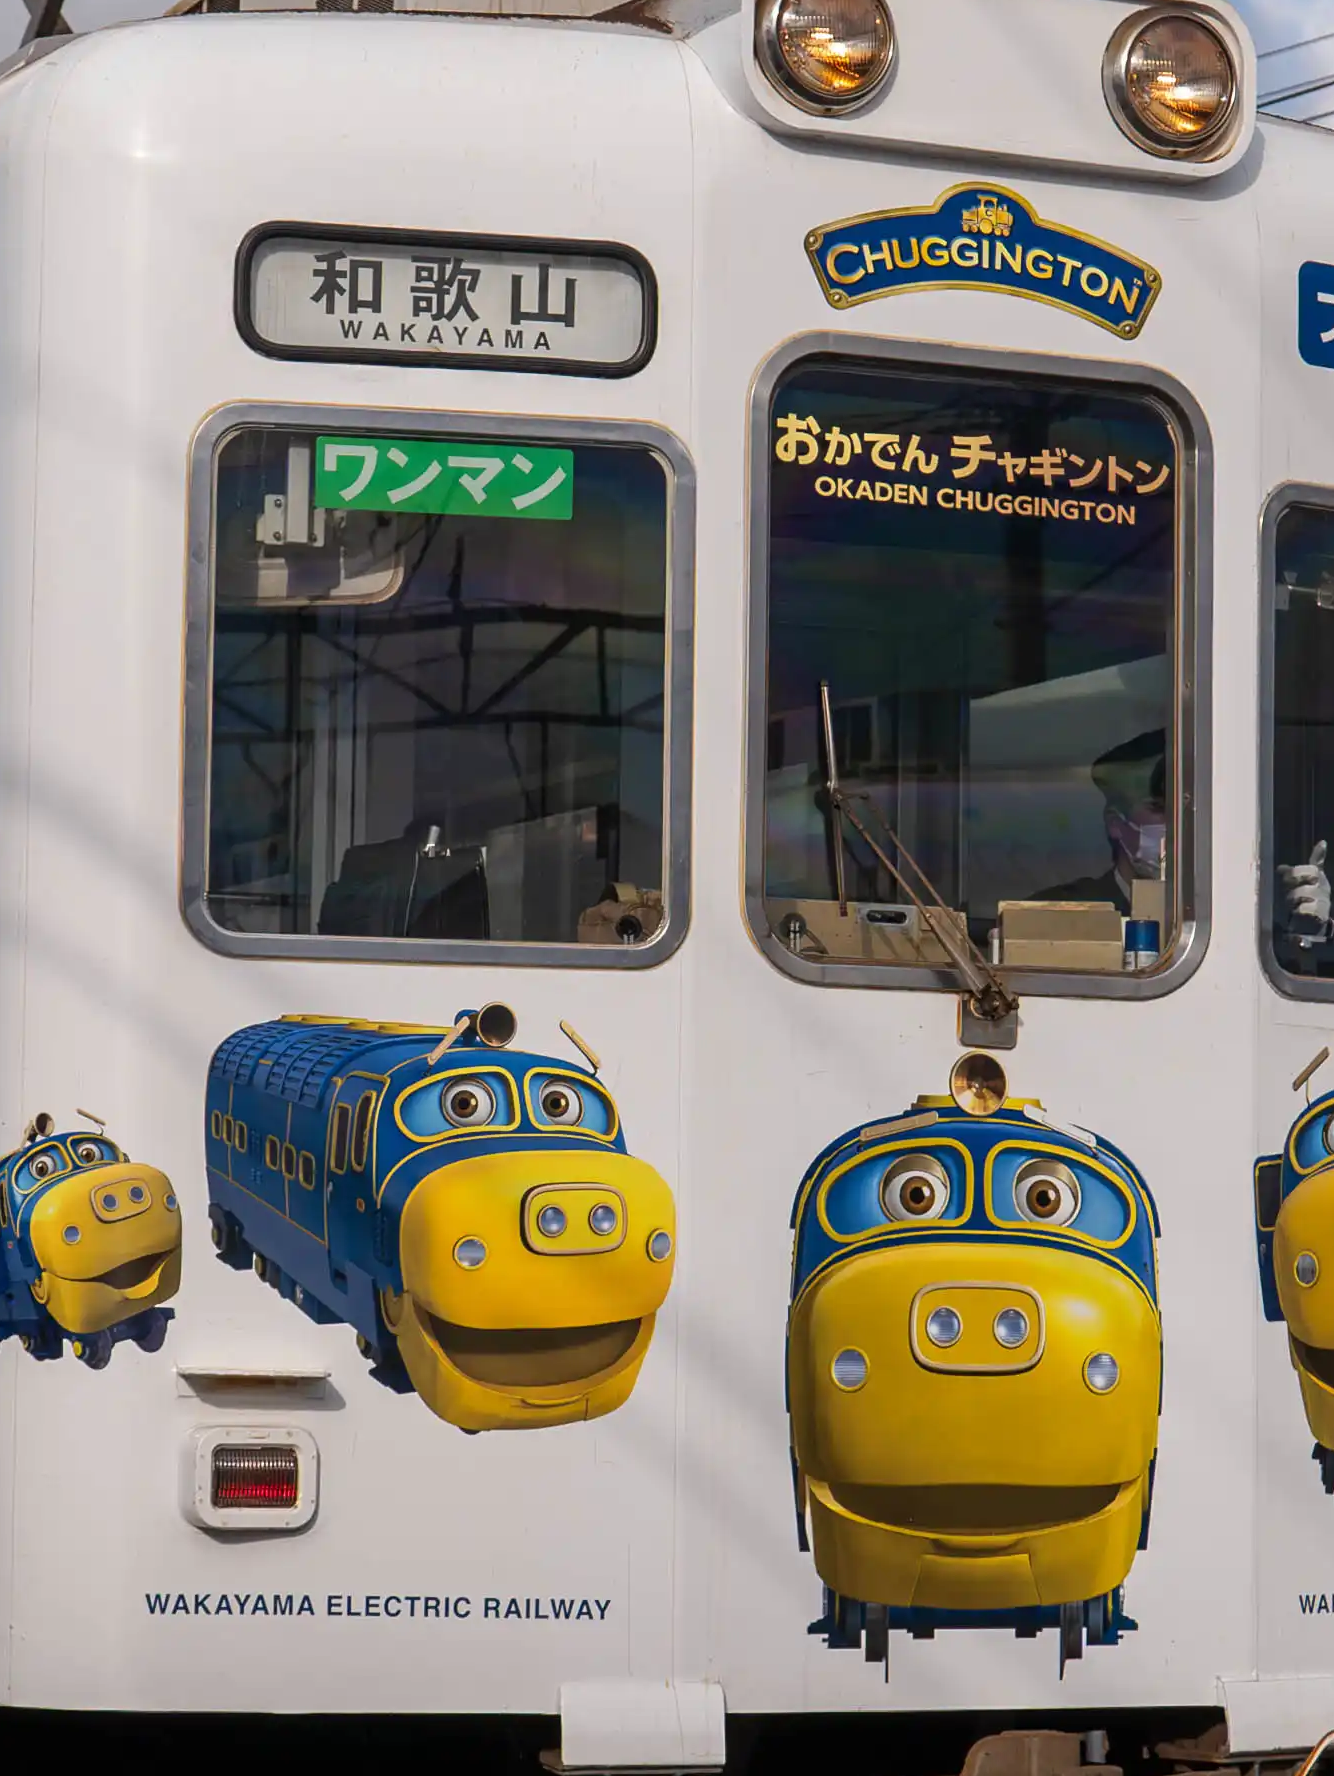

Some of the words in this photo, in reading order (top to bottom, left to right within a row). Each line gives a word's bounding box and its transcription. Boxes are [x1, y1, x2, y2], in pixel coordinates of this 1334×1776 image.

[310, 249, 578, 329] 和歌山
[825, 236, 1140, 315] CHUGGINGTON
[339, 319, 552, 351] WAKAYAMA
[321, 443, 567, 512] ワンマン
[814, 476, 929, 508] OKADEN
[935, 487, 1137, 527] CHUGGINGTON
[145, 1591, 316, 1618] WAKAYAMA
[326, 1594, 472, 1620] ELECTRIC
[483, 1597, 612, 1622] RAILWAY
